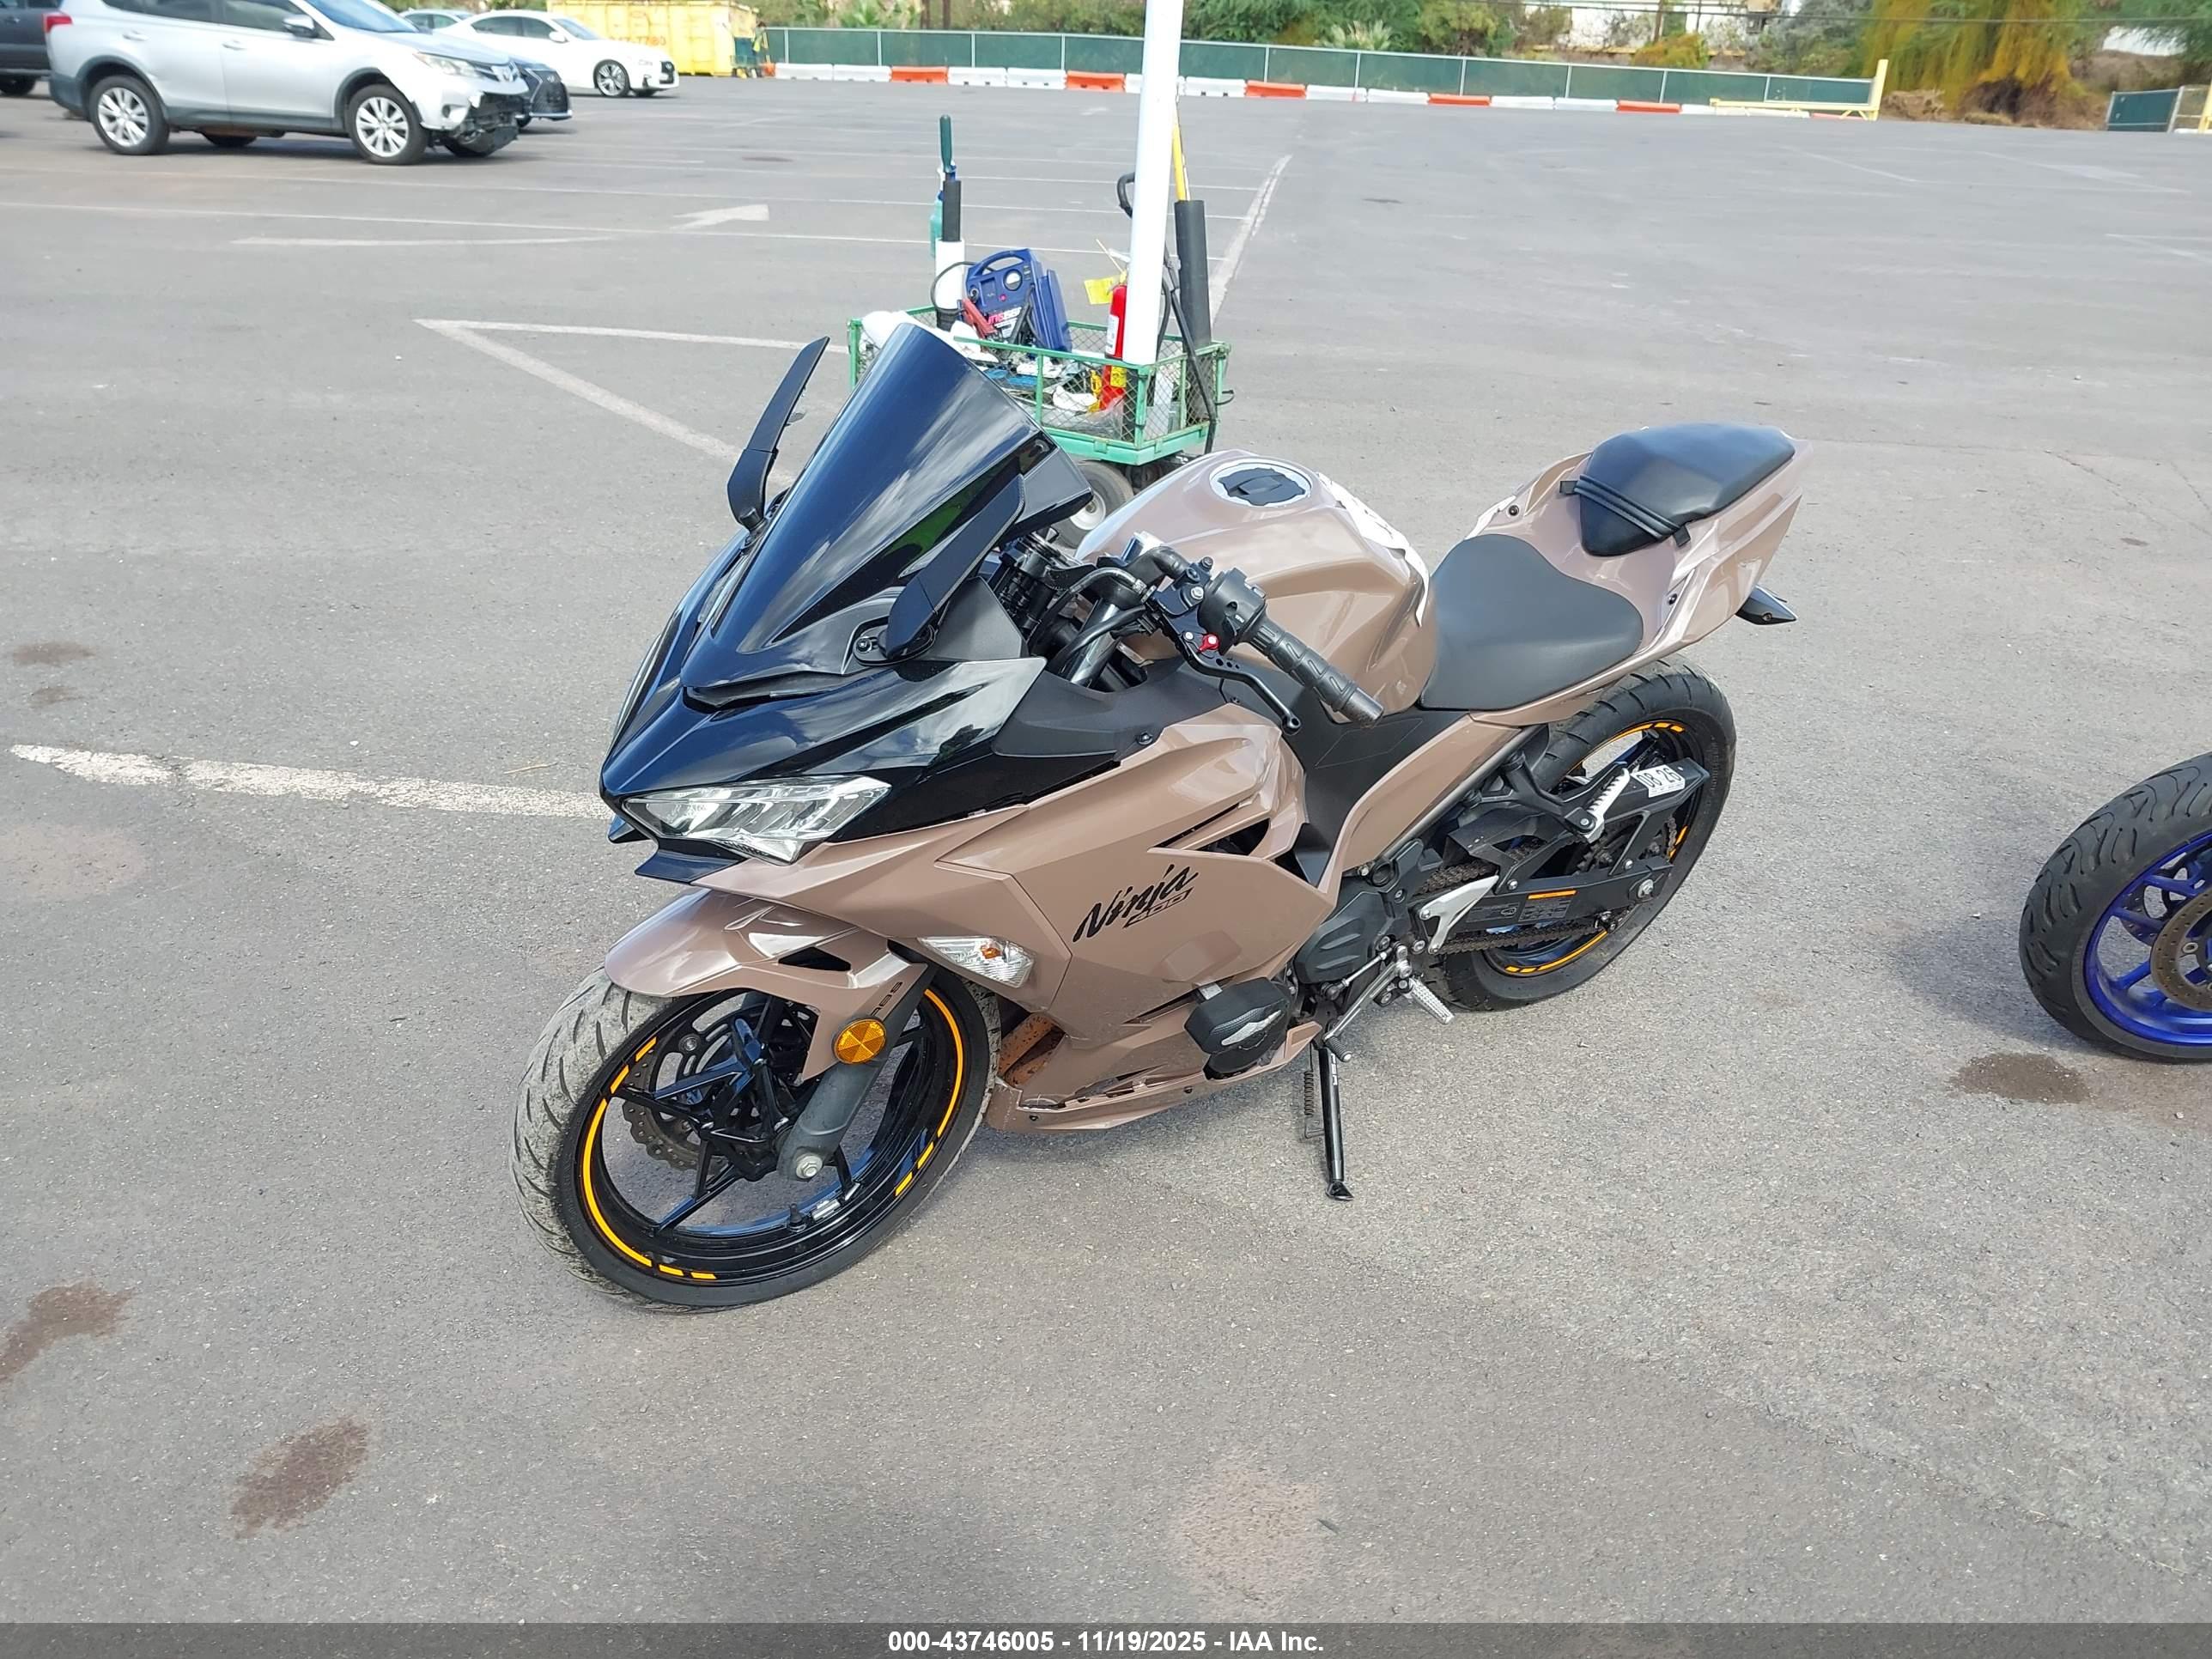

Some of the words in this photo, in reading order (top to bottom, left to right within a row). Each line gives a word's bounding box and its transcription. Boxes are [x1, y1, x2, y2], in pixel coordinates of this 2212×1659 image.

[1636, 773, 1663, 787] 08
[1656, 768, 1682, 783] 26
[1073, 864, 1200, 942] Ninja
[1122, 886, 1194, 929] 400
